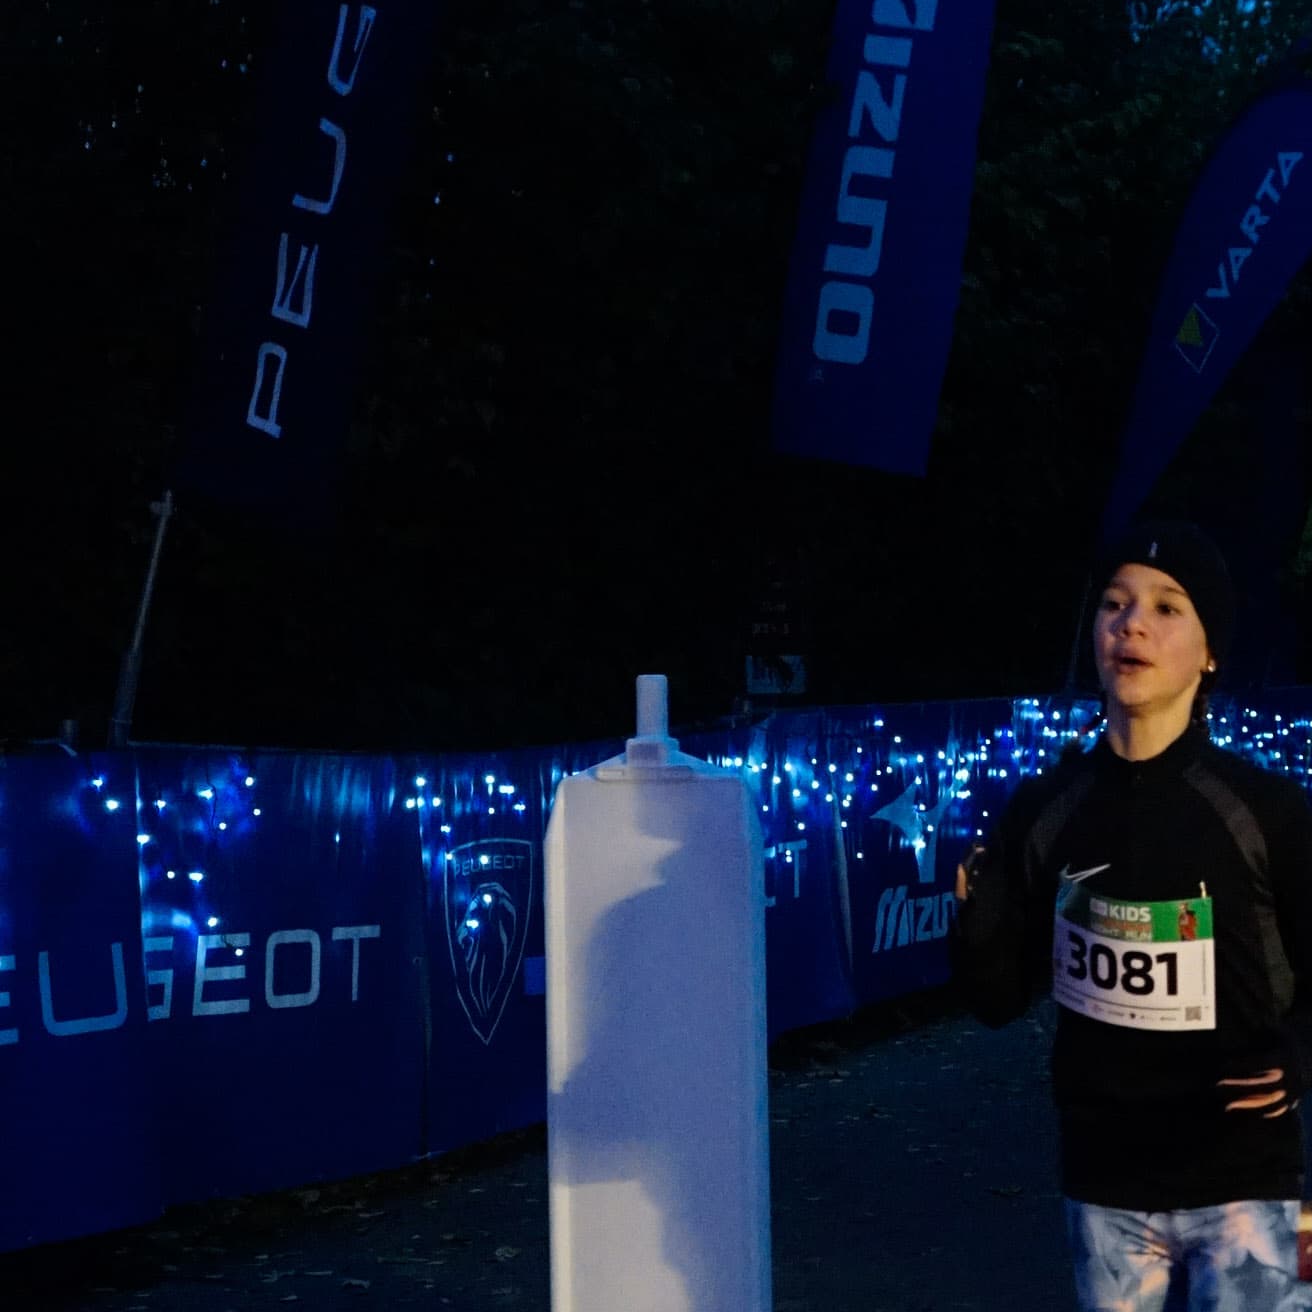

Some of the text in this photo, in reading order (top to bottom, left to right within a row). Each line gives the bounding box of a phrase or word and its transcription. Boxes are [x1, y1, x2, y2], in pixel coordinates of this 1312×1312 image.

[1205, 152, 1304, 299] VARTA
[1109, 904, 1152, 923] KIDS
[1067, 930, 1178, 996] 3081
